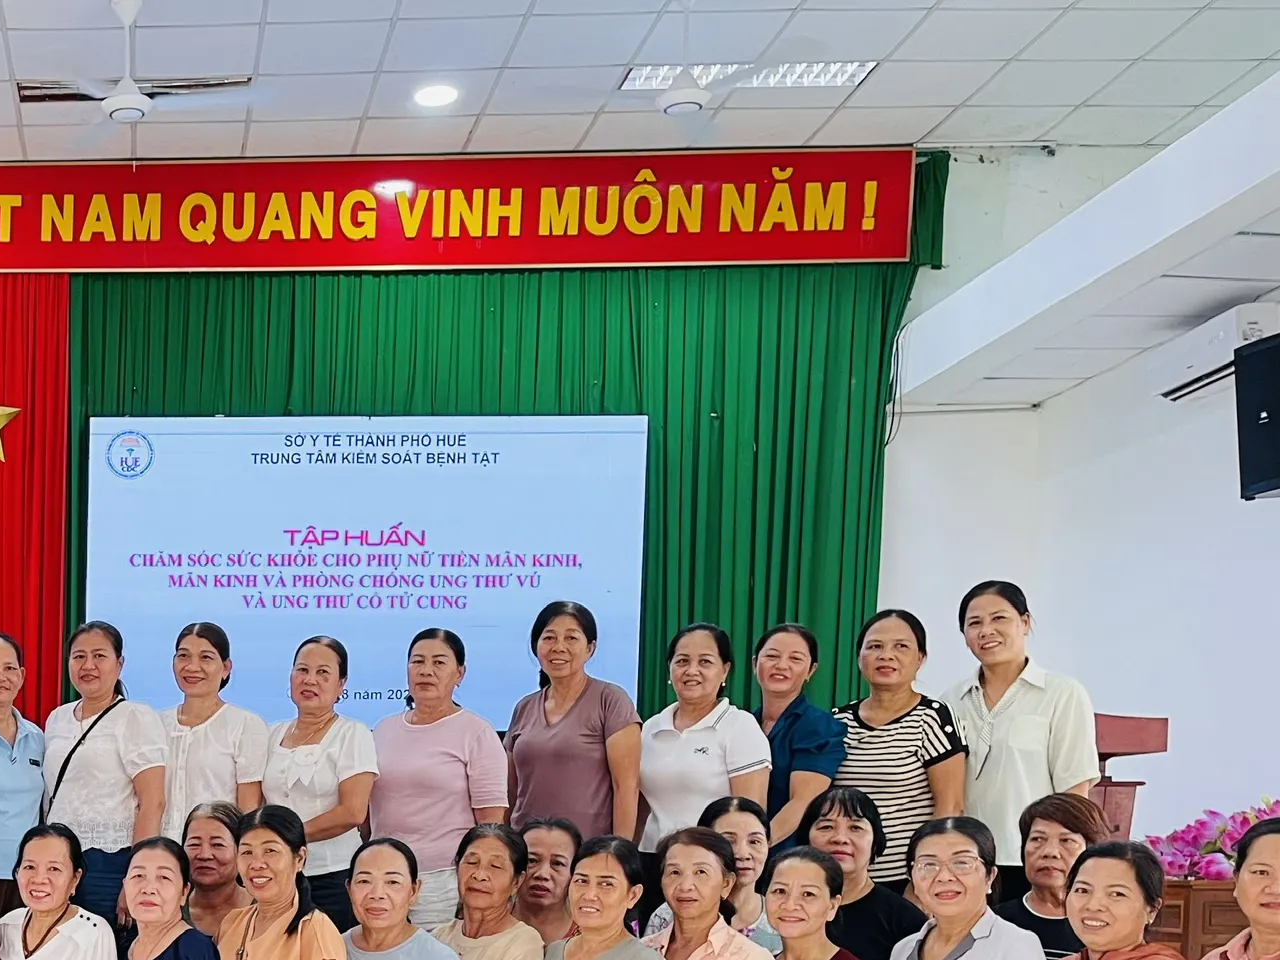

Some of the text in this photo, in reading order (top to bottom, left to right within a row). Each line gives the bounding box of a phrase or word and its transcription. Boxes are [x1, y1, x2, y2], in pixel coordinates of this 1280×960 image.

[40, 192, 161, 242] NAM
[179, 189, 376, 244] QUANG
[395, 187, 522, 239] VINH
[538, 168, 703, 236] MUÔN
[719, 167, 846, 232] NĂM
[310, 434, 319, 447] Y
[346, 431, 395, 447] THÀNH
[251, 452, 301, 464] TRUNG
[306, 449, 336, 464] TÂM
[381, 449, 422, 464] SOÁT
[426, 450, 466, 467] BỆNH
[472, 450, 500, 467] TẬT
[283, 522, 426, 549] TẬP HUẤN
[129, 551, 182, 567] CHĂM
[187, 550, 222, 567] SÓC
[226, 550, 262, 567] SỨC
[322, 553, 362, 567] CHO
[366, 553, 402, 570] PHỤ
[407, 550, 435, 567] NỮ
[485, 551, 526, 567] MÃN
[532, 553, 583, 569] KINH,
[168, 572, 208, 588] MÃN
[213, 574, 258, 588] KINH
[263, 570, 287, 588] VÀ
[292, 570, 354, 588] PHÒNG
[429, 574, 468, 588] UNG
[472, 573, 513, 588] THƯ
[516, 571, 541, 588] VÚ
[242, 591, 266, 608] VÀ
[272, 595, 309, 609] UNG
[313, 593, 353, 609] THƯ
[386, 591, 413, 609] TỬ
[417, 595, 468, 609] CUNG
[353, 690, 382, 700] năm
[387, 689, 410, 700] 202
